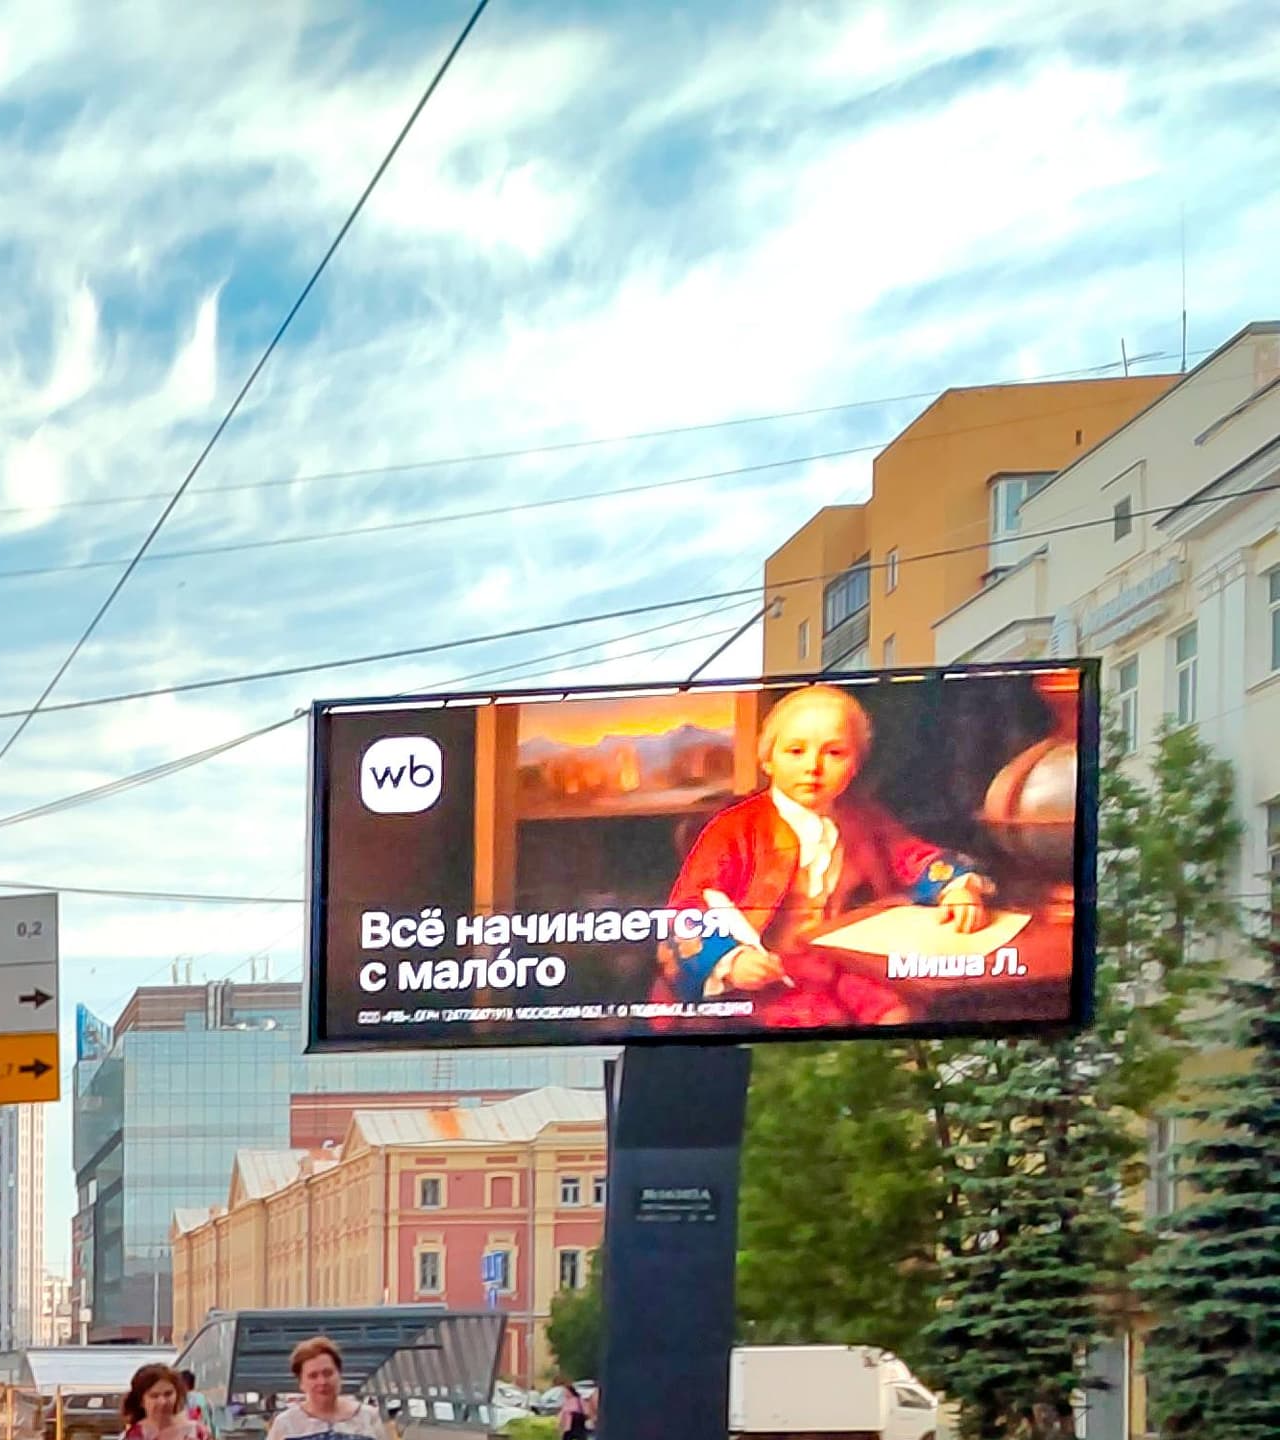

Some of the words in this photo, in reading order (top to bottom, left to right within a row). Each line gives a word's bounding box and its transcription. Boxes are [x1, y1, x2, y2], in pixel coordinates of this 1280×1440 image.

[369, 754, 435, 790] wb
[16, 921, 43, 938] 0,2
[360, 908, 446, 950] Всё
[457, 907, 737, 946] начинается
[359, 965, 387, 992] с
[888, 952, 986, 979] Миша
[991, 947, 1028, 976] Л.
